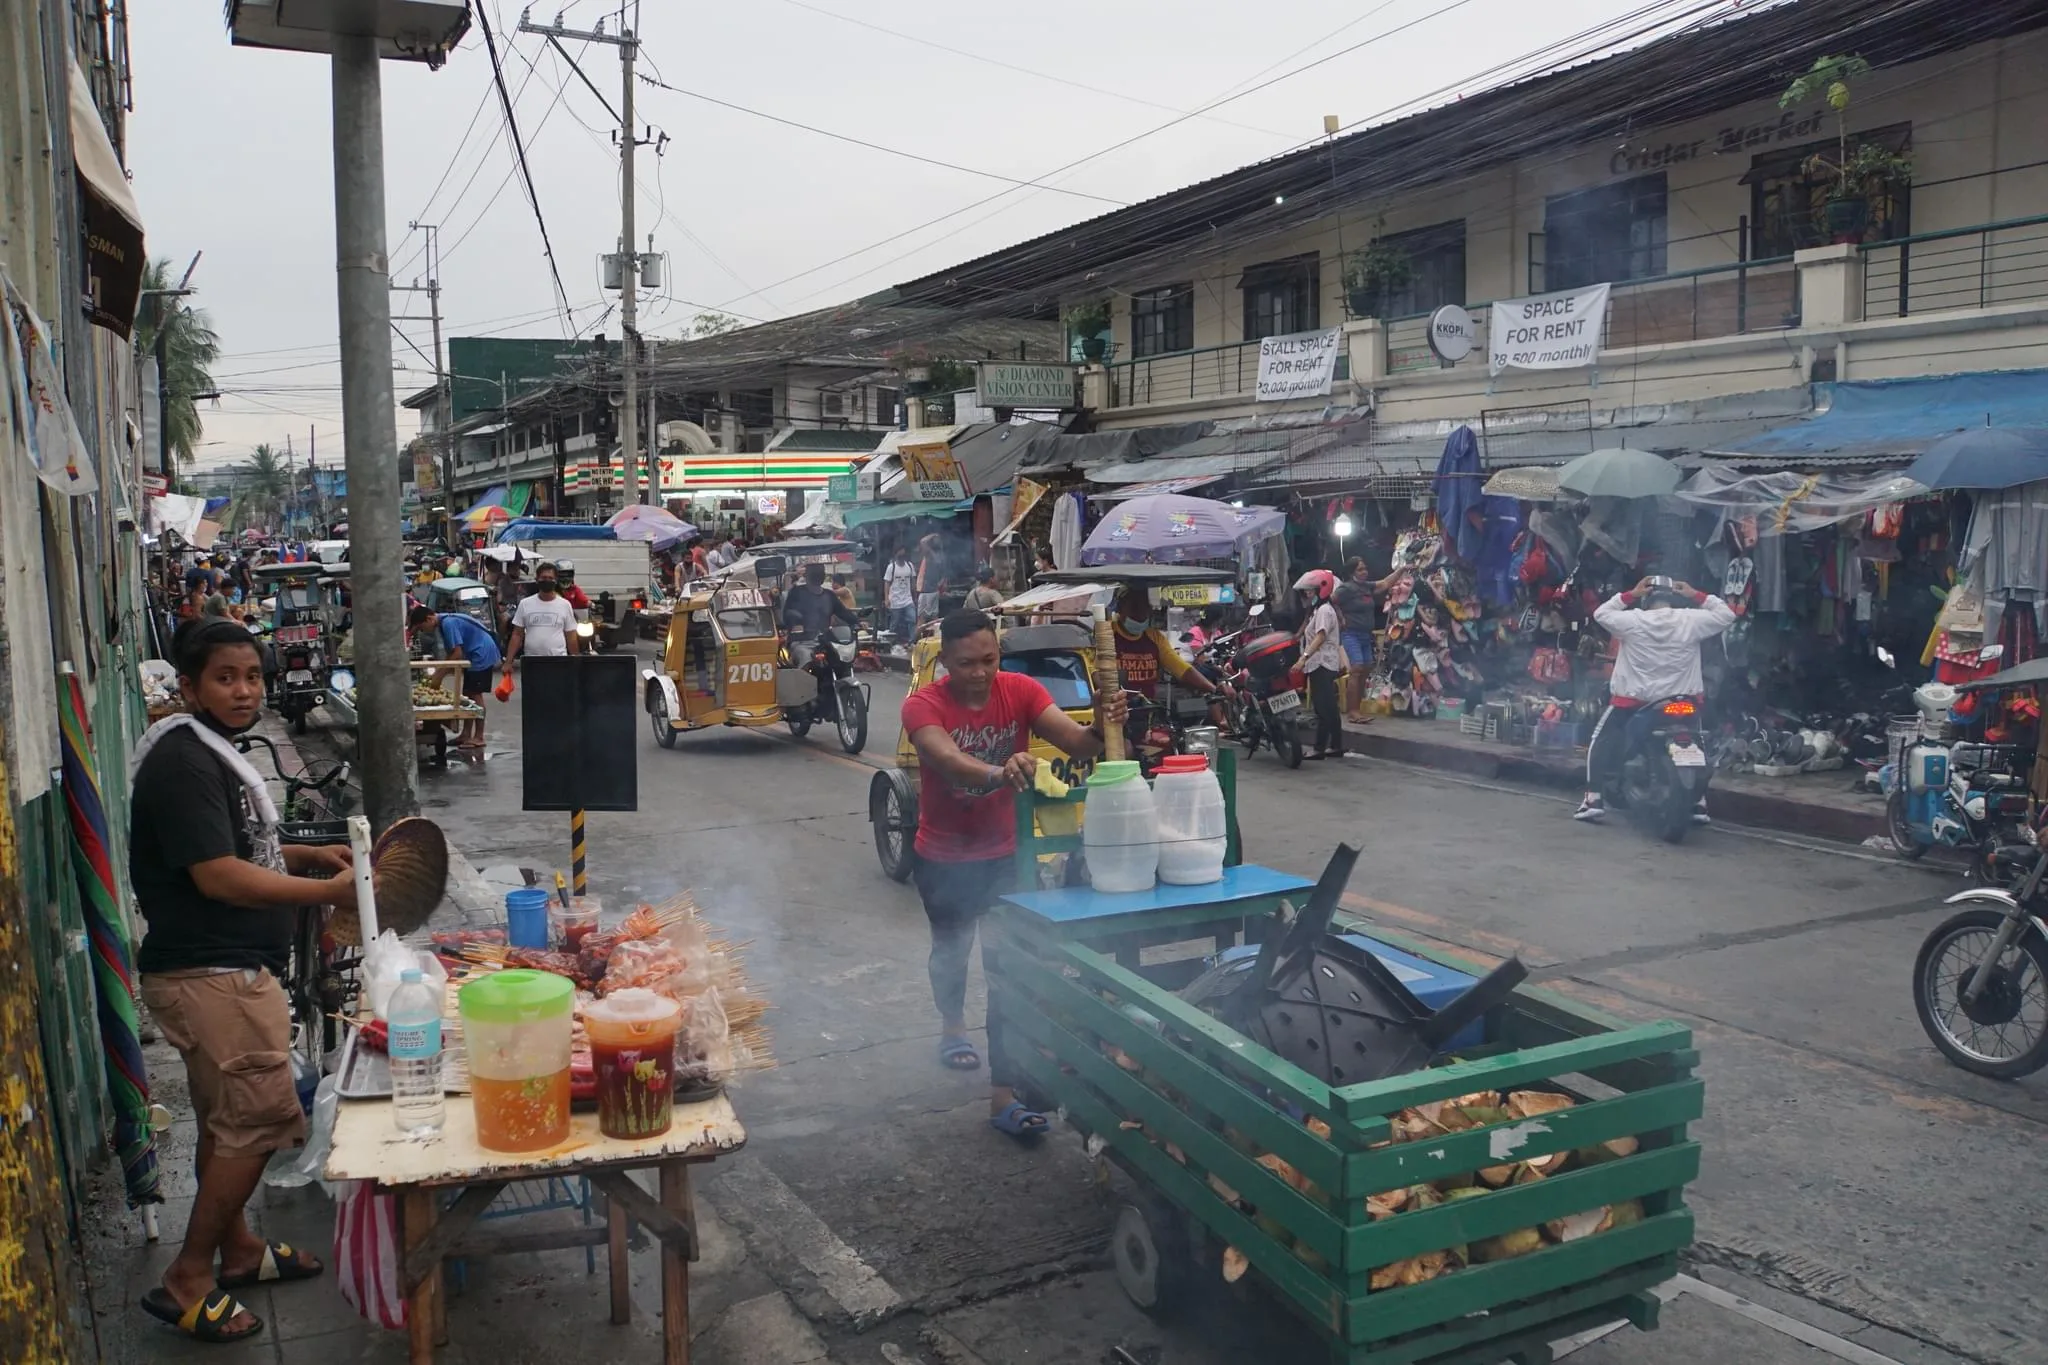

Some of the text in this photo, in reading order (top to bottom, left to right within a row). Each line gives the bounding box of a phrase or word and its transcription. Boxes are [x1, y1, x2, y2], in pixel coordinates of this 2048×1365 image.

[1523, 297, 1576, 319] SPACE
[1506, 319, 1587, 344] FOR RENT
[1262, 334, 1335, 355] STALL SPACE
[1538, 344, 1592, 362] monthly
[1010, 367, 1064, 382] DIAMOND
[1268, 356, 1324, 375] FOR RENT
[987, 381, 1072, 397] VISION CENTER
[728, 662, 773, 684] 2703
